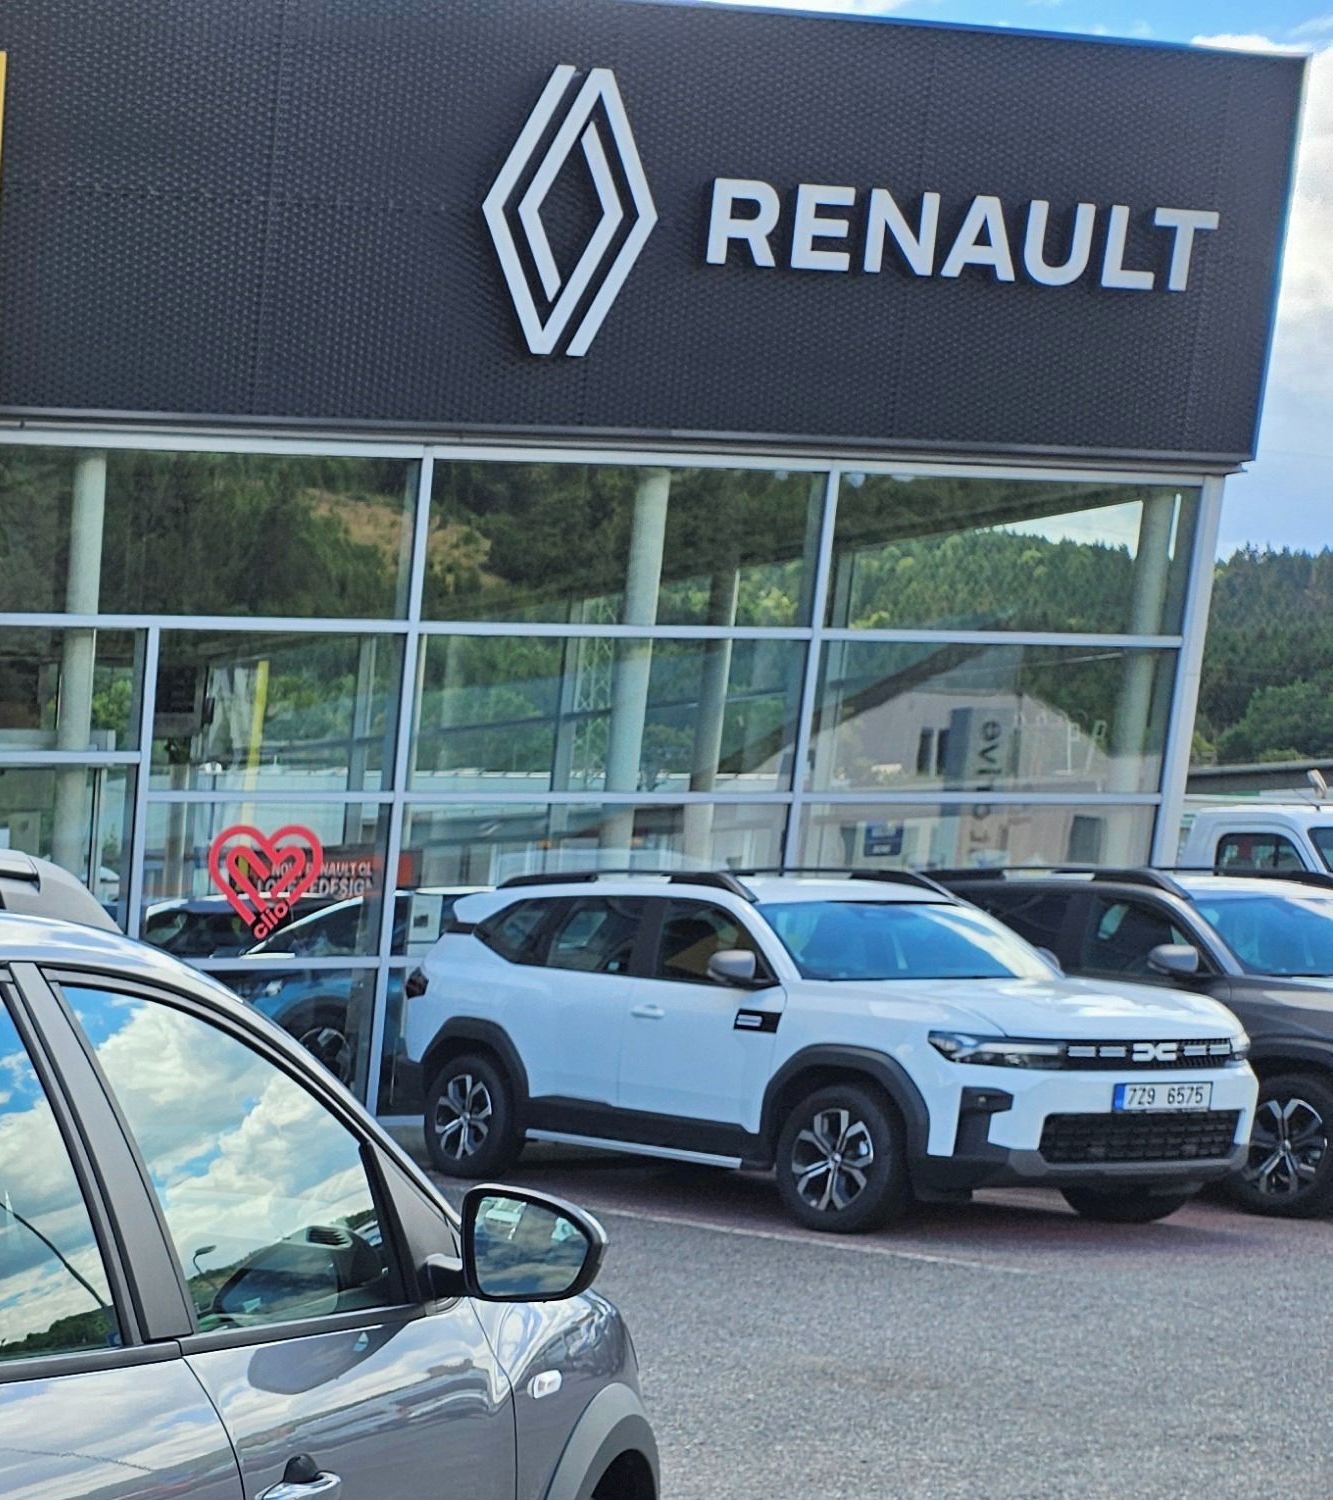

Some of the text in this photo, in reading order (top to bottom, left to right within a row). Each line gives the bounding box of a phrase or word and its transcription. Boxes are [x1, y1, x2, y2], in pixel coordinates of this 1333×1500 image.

[705, 177, 1220, 293] RENAULT
[253, 900, 289, 940] clio
[1127, 1086, 1204, 1105] 7Z9 6575
